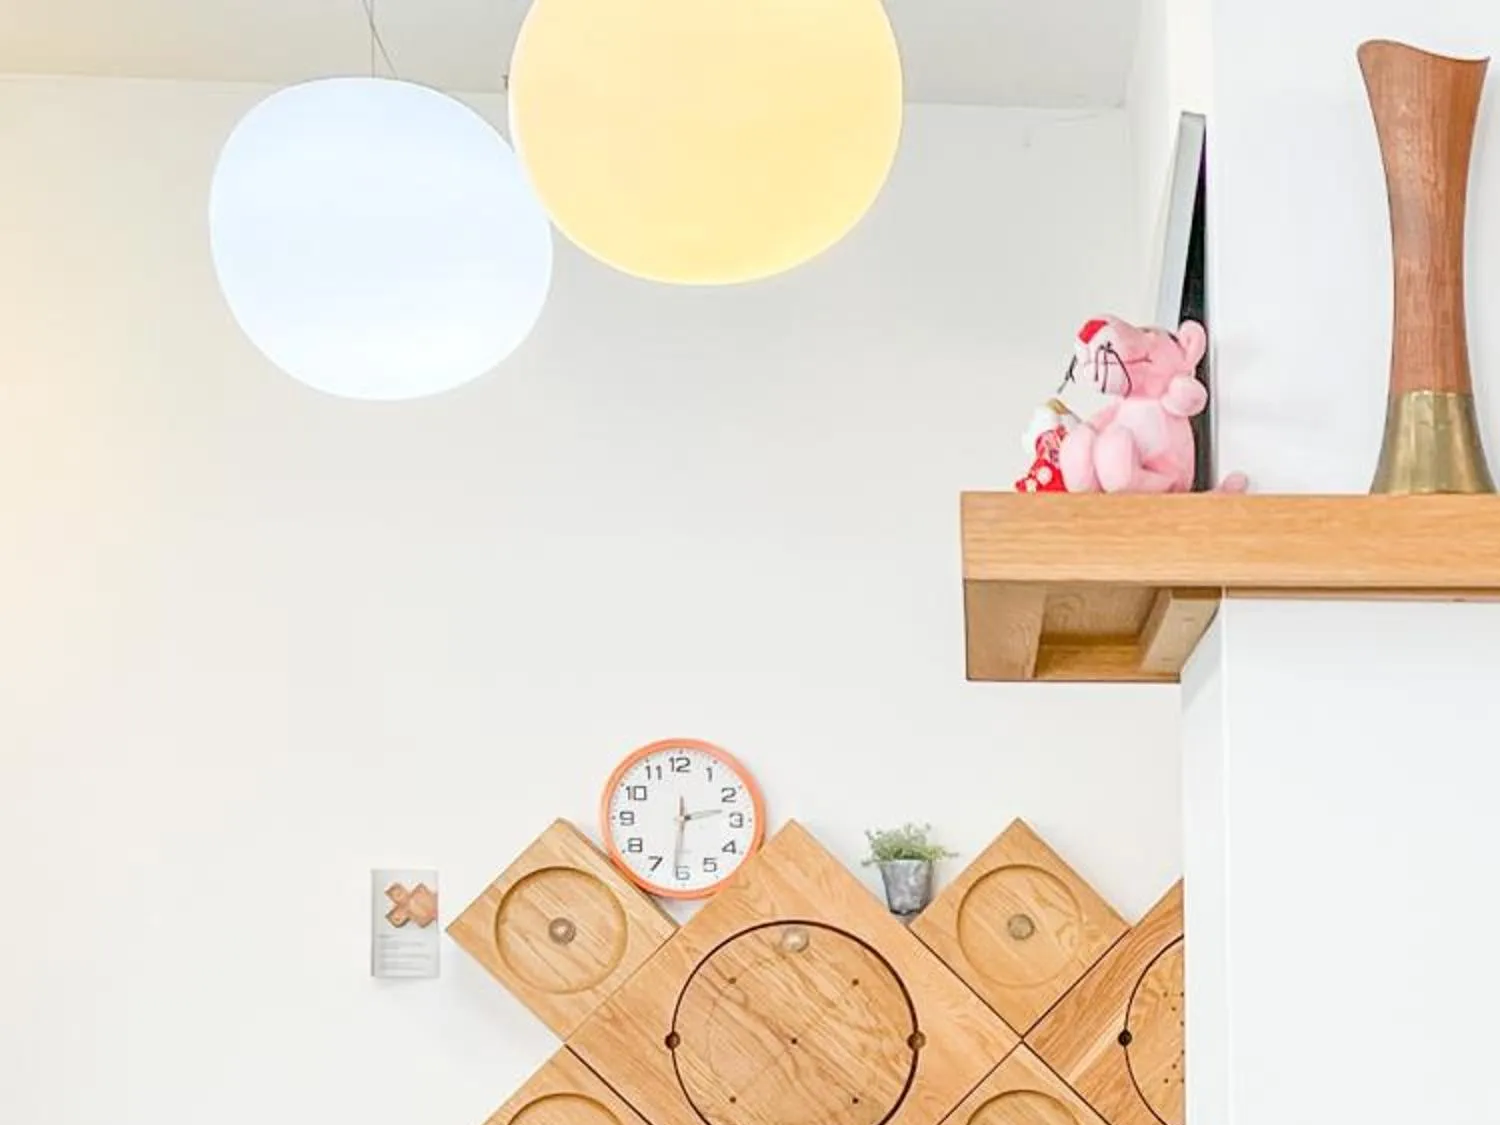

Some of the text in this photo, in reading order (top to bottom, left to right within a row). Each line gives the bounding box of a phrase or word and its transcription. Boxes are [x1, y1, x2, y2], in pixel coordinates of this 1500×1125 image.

[645, 764, 663, 780] 11
[669, 757, 691, 773] 12
[706, 767, 714, 782] 1
[625, 785, 648, 801] 10
[721, 787, 737, 803] 2
[619, 811, 635, 826] 9
[729, 812, 744, 828] 3
[627, 837, 643, 853] 8
[721, 840, 737, 854] 4
[648, 855, 663, 872] 7
[703, 857, 718, 873] 5
[675, 865, 691, 881] 6
